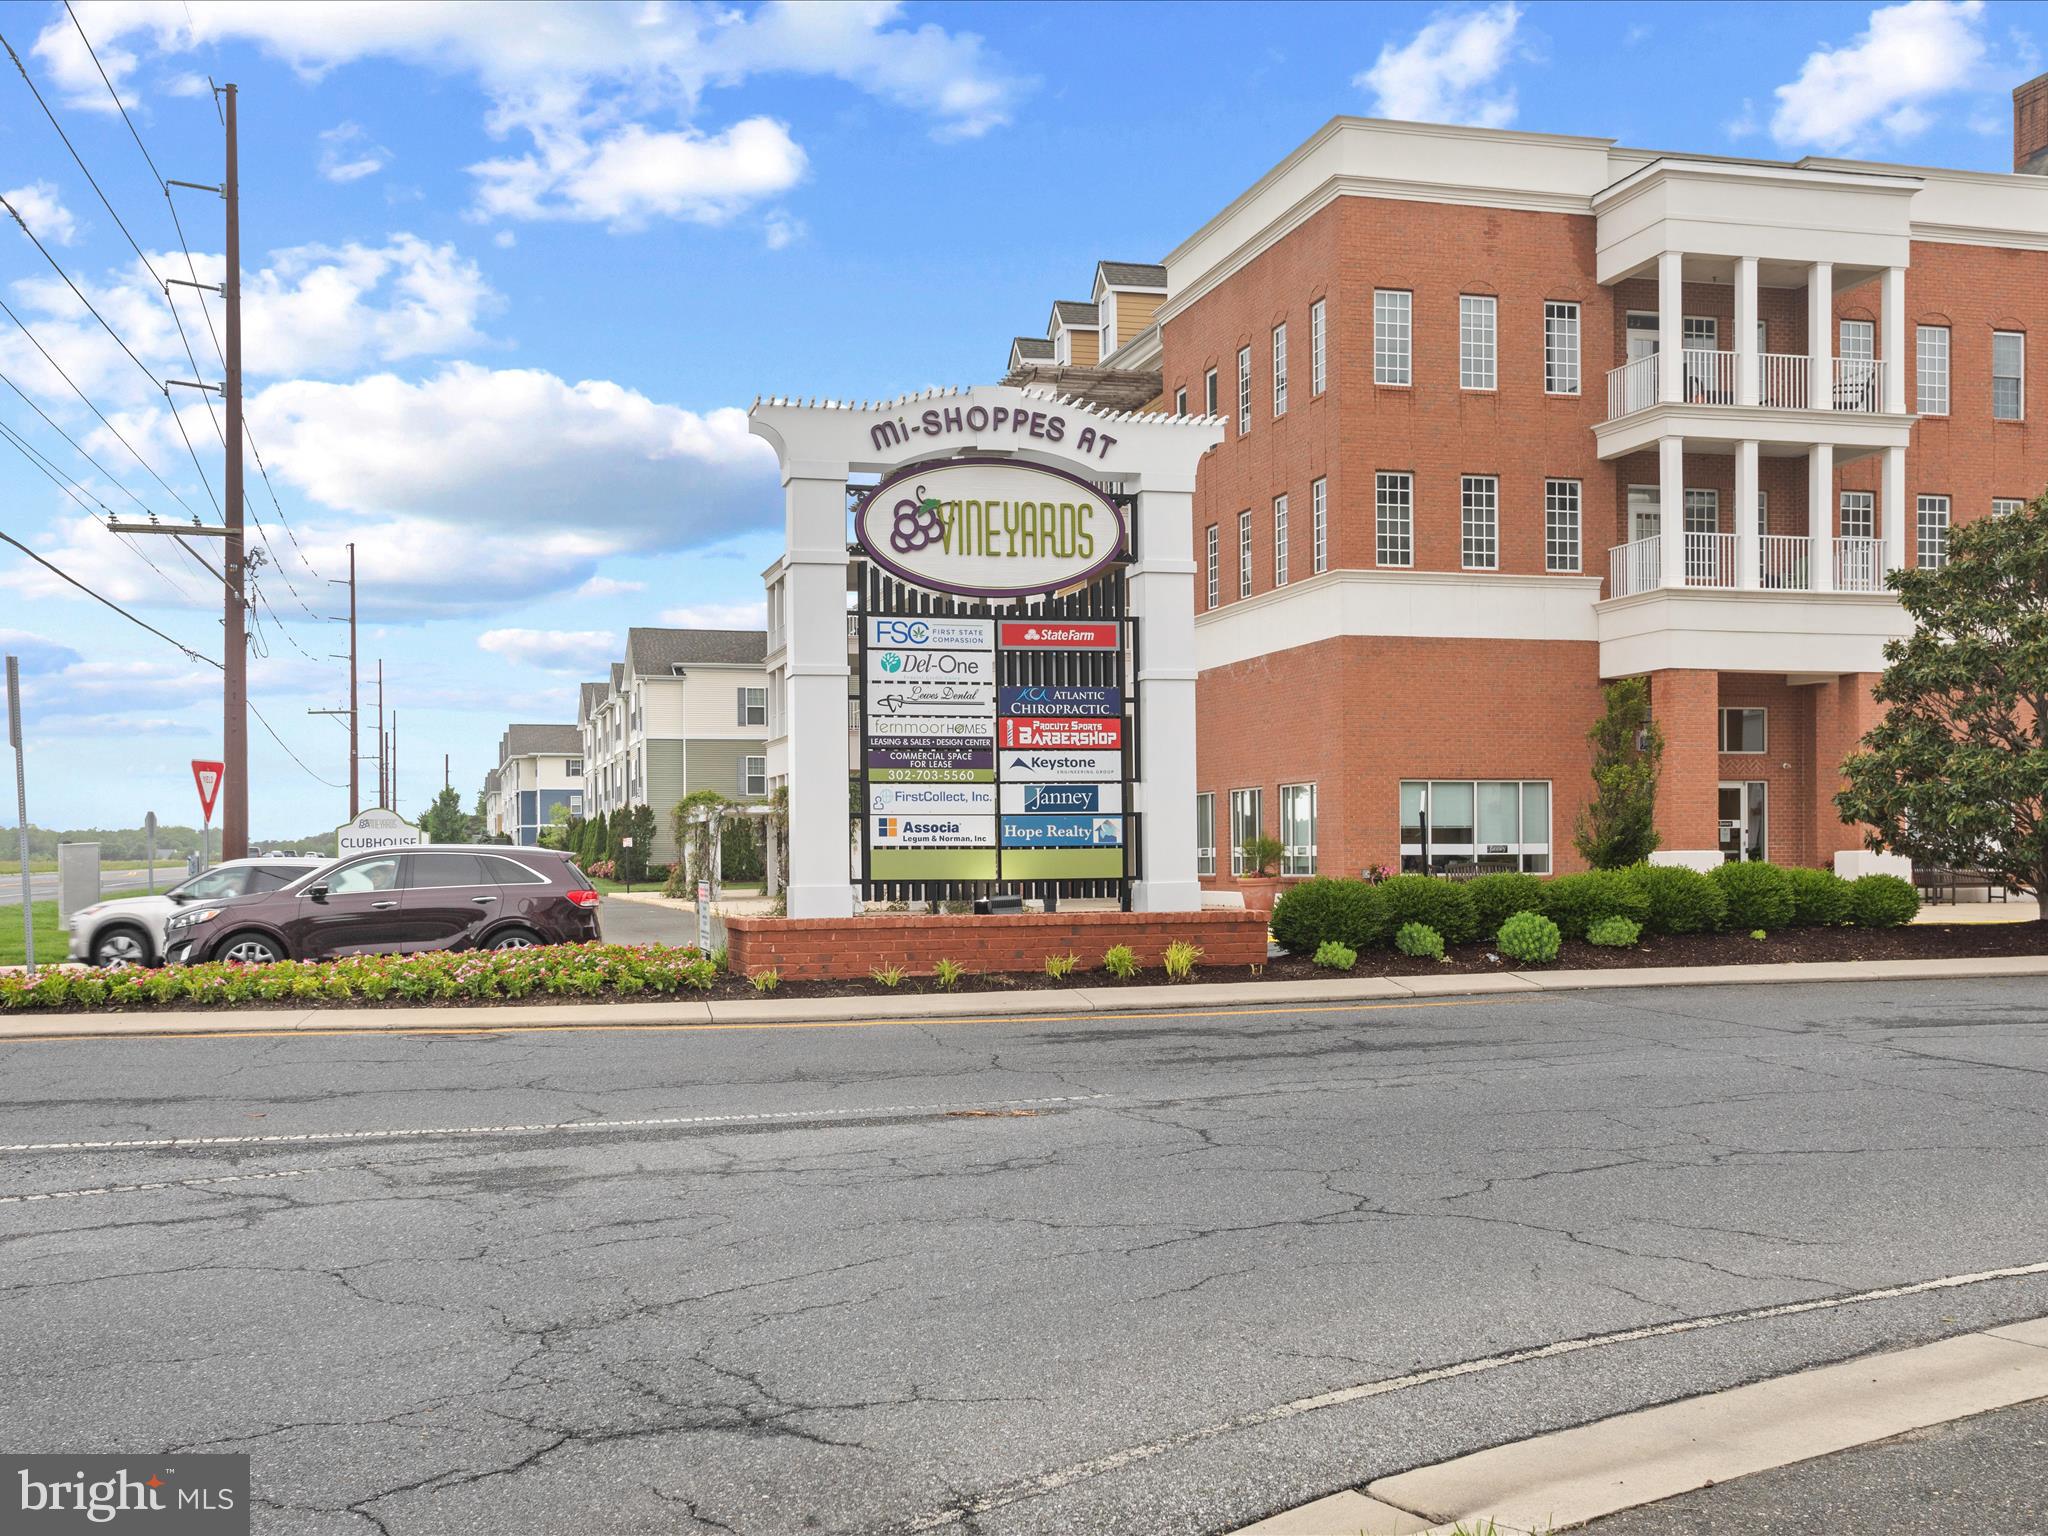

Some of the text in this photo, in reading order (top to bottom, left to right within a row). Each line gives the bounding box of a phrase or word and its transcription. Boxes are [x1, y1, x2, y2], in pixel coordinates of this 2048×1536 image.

[1076, 427, 1117, 459] AT
[936, 500, 1094, 558] VINEYARDS
[877, 620, 929, 644] FSC
[932, 628, 956, 636] FIRST
[902, 653, 979, 675] Del-One
[907, 686, 979, 701] Lewes Dental
[875, 719, 987, 734] fernmoor HOMES
[870, 738, 991, 746] LEASING & SALES DESIGN CENTER
[889, 752, 973, 760] COMMERCIAL SPACE
[910, 760, 952, 768] FOR LEASE
[1031, 757, 1096, 770] Keystone
[888, 770, 975, 781] 302-703-5560
[895, 791, 992, 803] FirstCollect, Inc.
[1031, 786, 1093, 810] Janney
[903, 821, 960, 833] Associa
[1003, 825, 1092, 841] Hope Realty
[340, 837, 417, 849] CLUBHOUSE
[902, 835, 930, 843] Legum
[939, 835, 973, 843] Norman,
